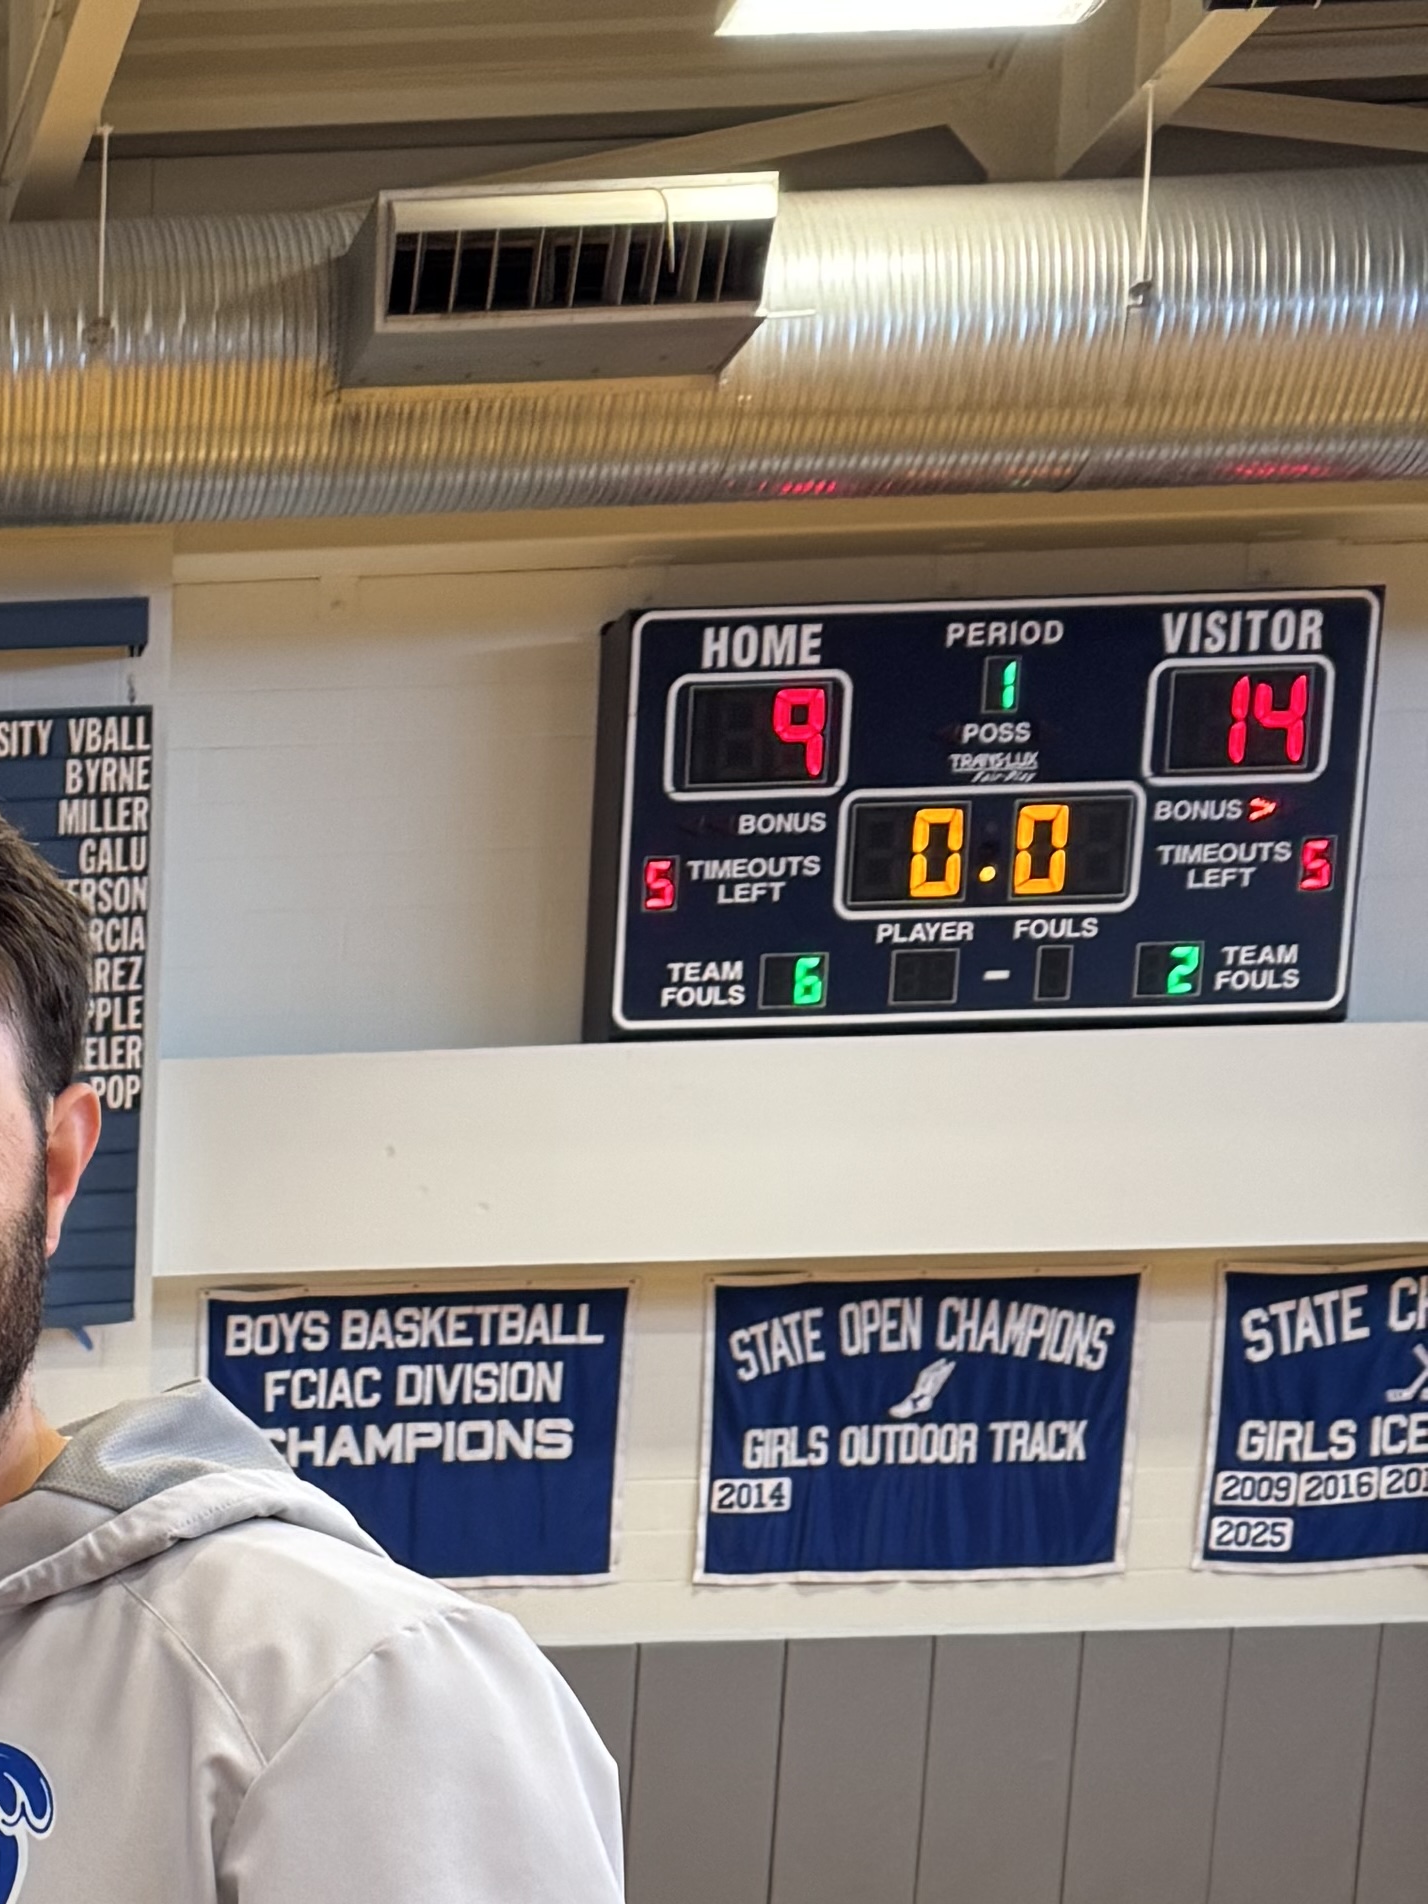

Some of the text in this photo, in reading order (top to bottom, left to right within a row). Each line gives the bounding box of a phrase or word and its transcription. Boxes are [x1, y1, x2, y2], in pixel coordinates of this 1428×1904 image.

[701, 623, 823, 669] HOME
[946, 620, 1064, 648] PERIOD
[1162, 609, 1324, 654] VISITOR
[1002, 660, 1017, 710] 1
[68, 716, 150, 754] VBALL
[773, 687, 827, 778] 9
[963, 722, 1032, 745] POSS
[1227, 675, 1307, 764] 14
[65, 755, 150, 794] BYRNE
[58, 796, 149, 836] MILLER
[738, 811, 827, 835] BONUS
[1153, 799, 1243, 822] BONUS
[79, 837, 148, 874] GALU
[687, 855, 822, 881] TIMEOUTS
[909, 804, 1069, 898] 0.0
[1157, 841, 1293, 866] TIMEOUTS
[1299, 838, 1332, 892] 5
[645, 859, 675, 910] 5
[717, 882, 787, 905] LEFT
[1186, 867, 1257, 890] LEFT
[876, 917, 1099, 944] PLAYER FOULS
[667, 960, 744, 983] TEAM
[1167, 945, 1200, 995] 2
[1222, 943, 1299, 967] TEAM
[660, 984, 746, 1008] FOULS
[793, 956, 823, 1006] 6
[1214, 968, 1300, 992] FOULS
[225, 1303, 605, 1357] BOYS BASKETBALL
[728, 1296, 1116, 1383] STATE OPEN CHAMPIONS
[1240, 1284, 1371, 1364] STATE
[264, 1360, 564, 1413] FCIAC DIVISION
[743, 1418, 1089, 1470] GIRLS OUTDOOR TRACK
[1236, 1411, 1428, 1462] GIRLS ICE
[717, 1482, 786, 1510] 2014
[1220, 1475, 1292, 1502] 2009
[1306, 1471, 1374, 1500] 2016
[1215, 1520, 1287, 1548] 2025
